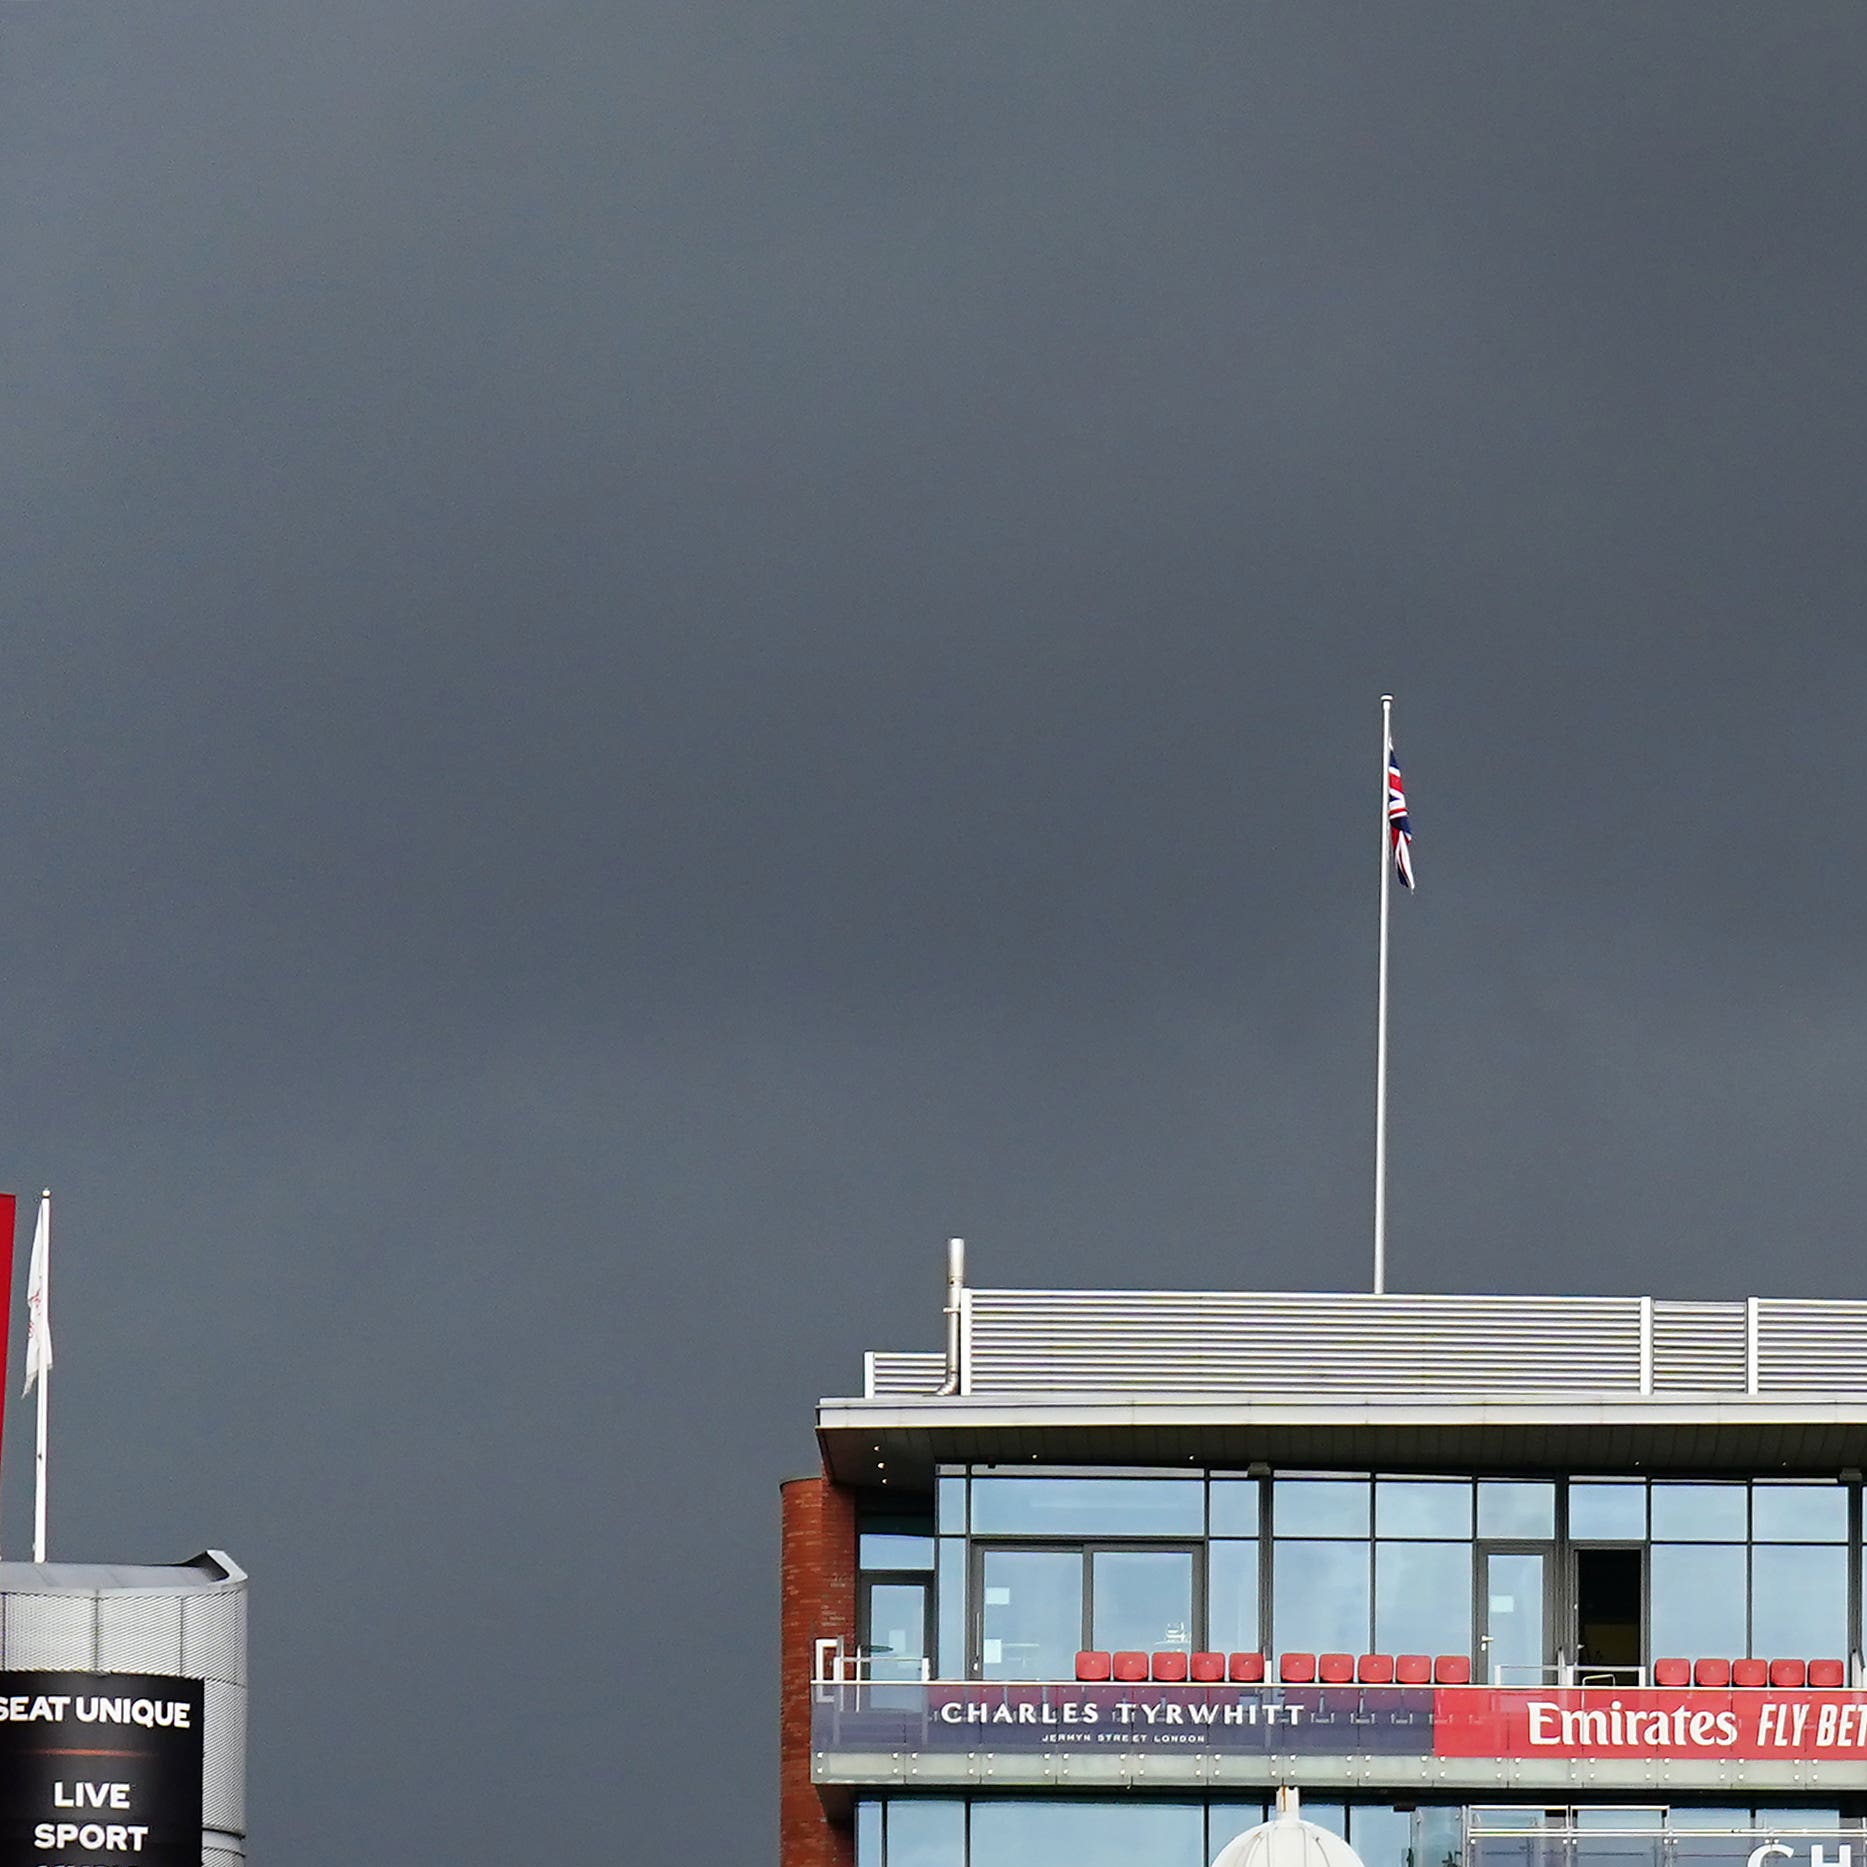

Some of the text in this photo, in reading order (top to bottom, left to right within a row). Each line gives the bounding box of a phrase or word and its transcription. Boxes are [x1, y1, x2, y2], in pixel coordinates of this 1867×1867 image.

[75, 1697, 191, 1728] UNIQUE
[940, 1702, 1304, 1725] CHARLES TYRWHITT
[1526, 1701, 1738, 1748] Emirates
[1756, 1703, 1809, 1747] FLY
[1042, 1733, 1205, 1743] JERMYN STREET LONDON
[54, 1782, 131, 1809] LIVE
[34, 1824, 149, 1851] SPORT
